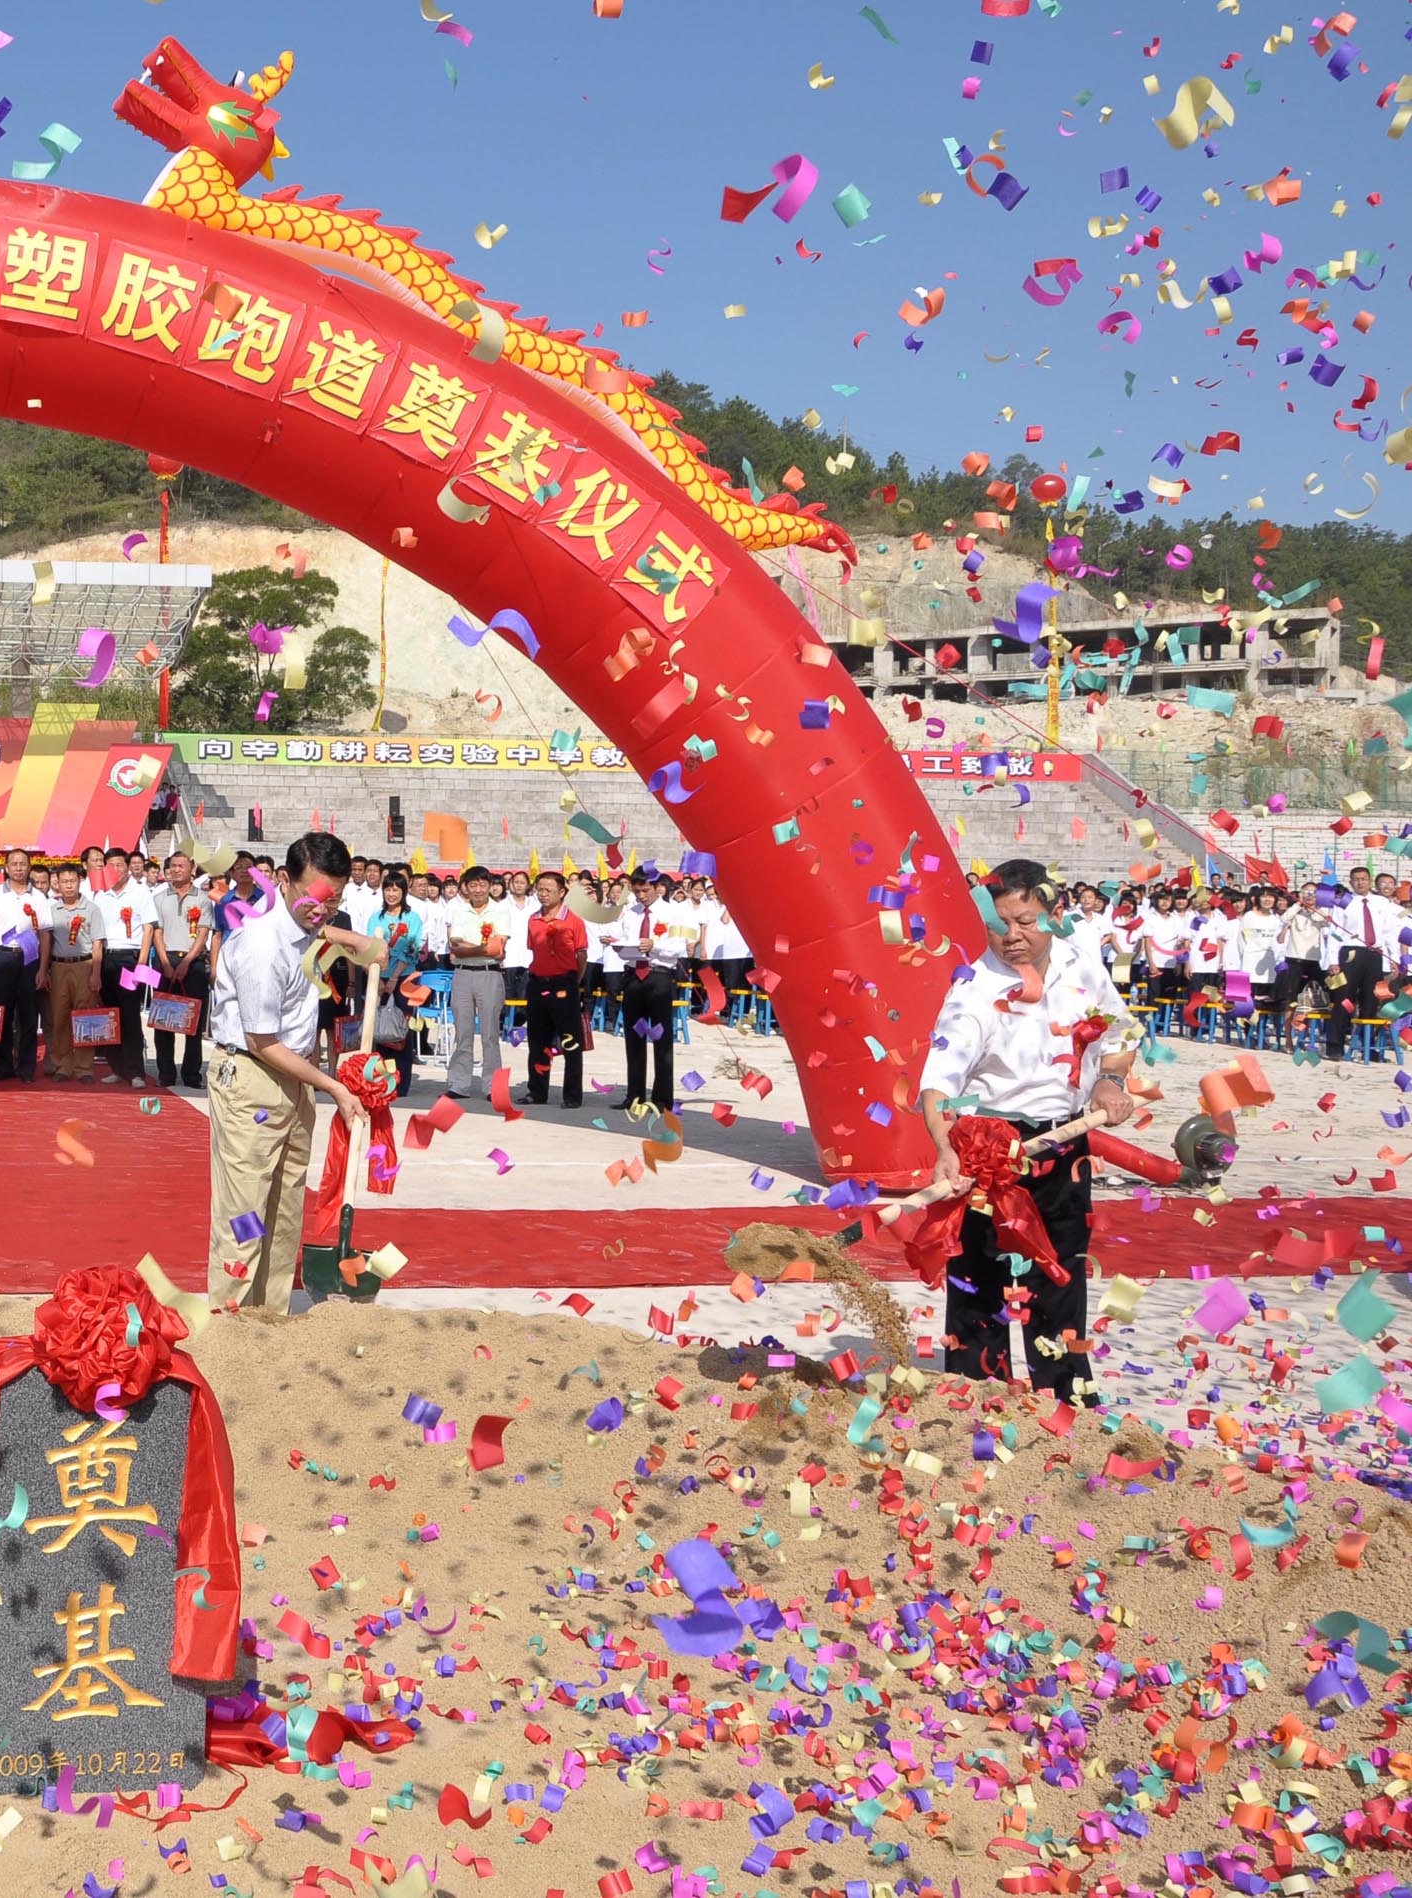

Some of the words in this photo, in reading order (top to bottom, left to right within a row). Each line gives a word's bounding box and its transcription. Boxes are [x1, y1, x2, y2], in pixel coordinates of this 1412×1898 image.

[197, 738, 626, 767] 向辛勤耕耘实验中学教
[21, 1411, 166, 1722] 奠基
